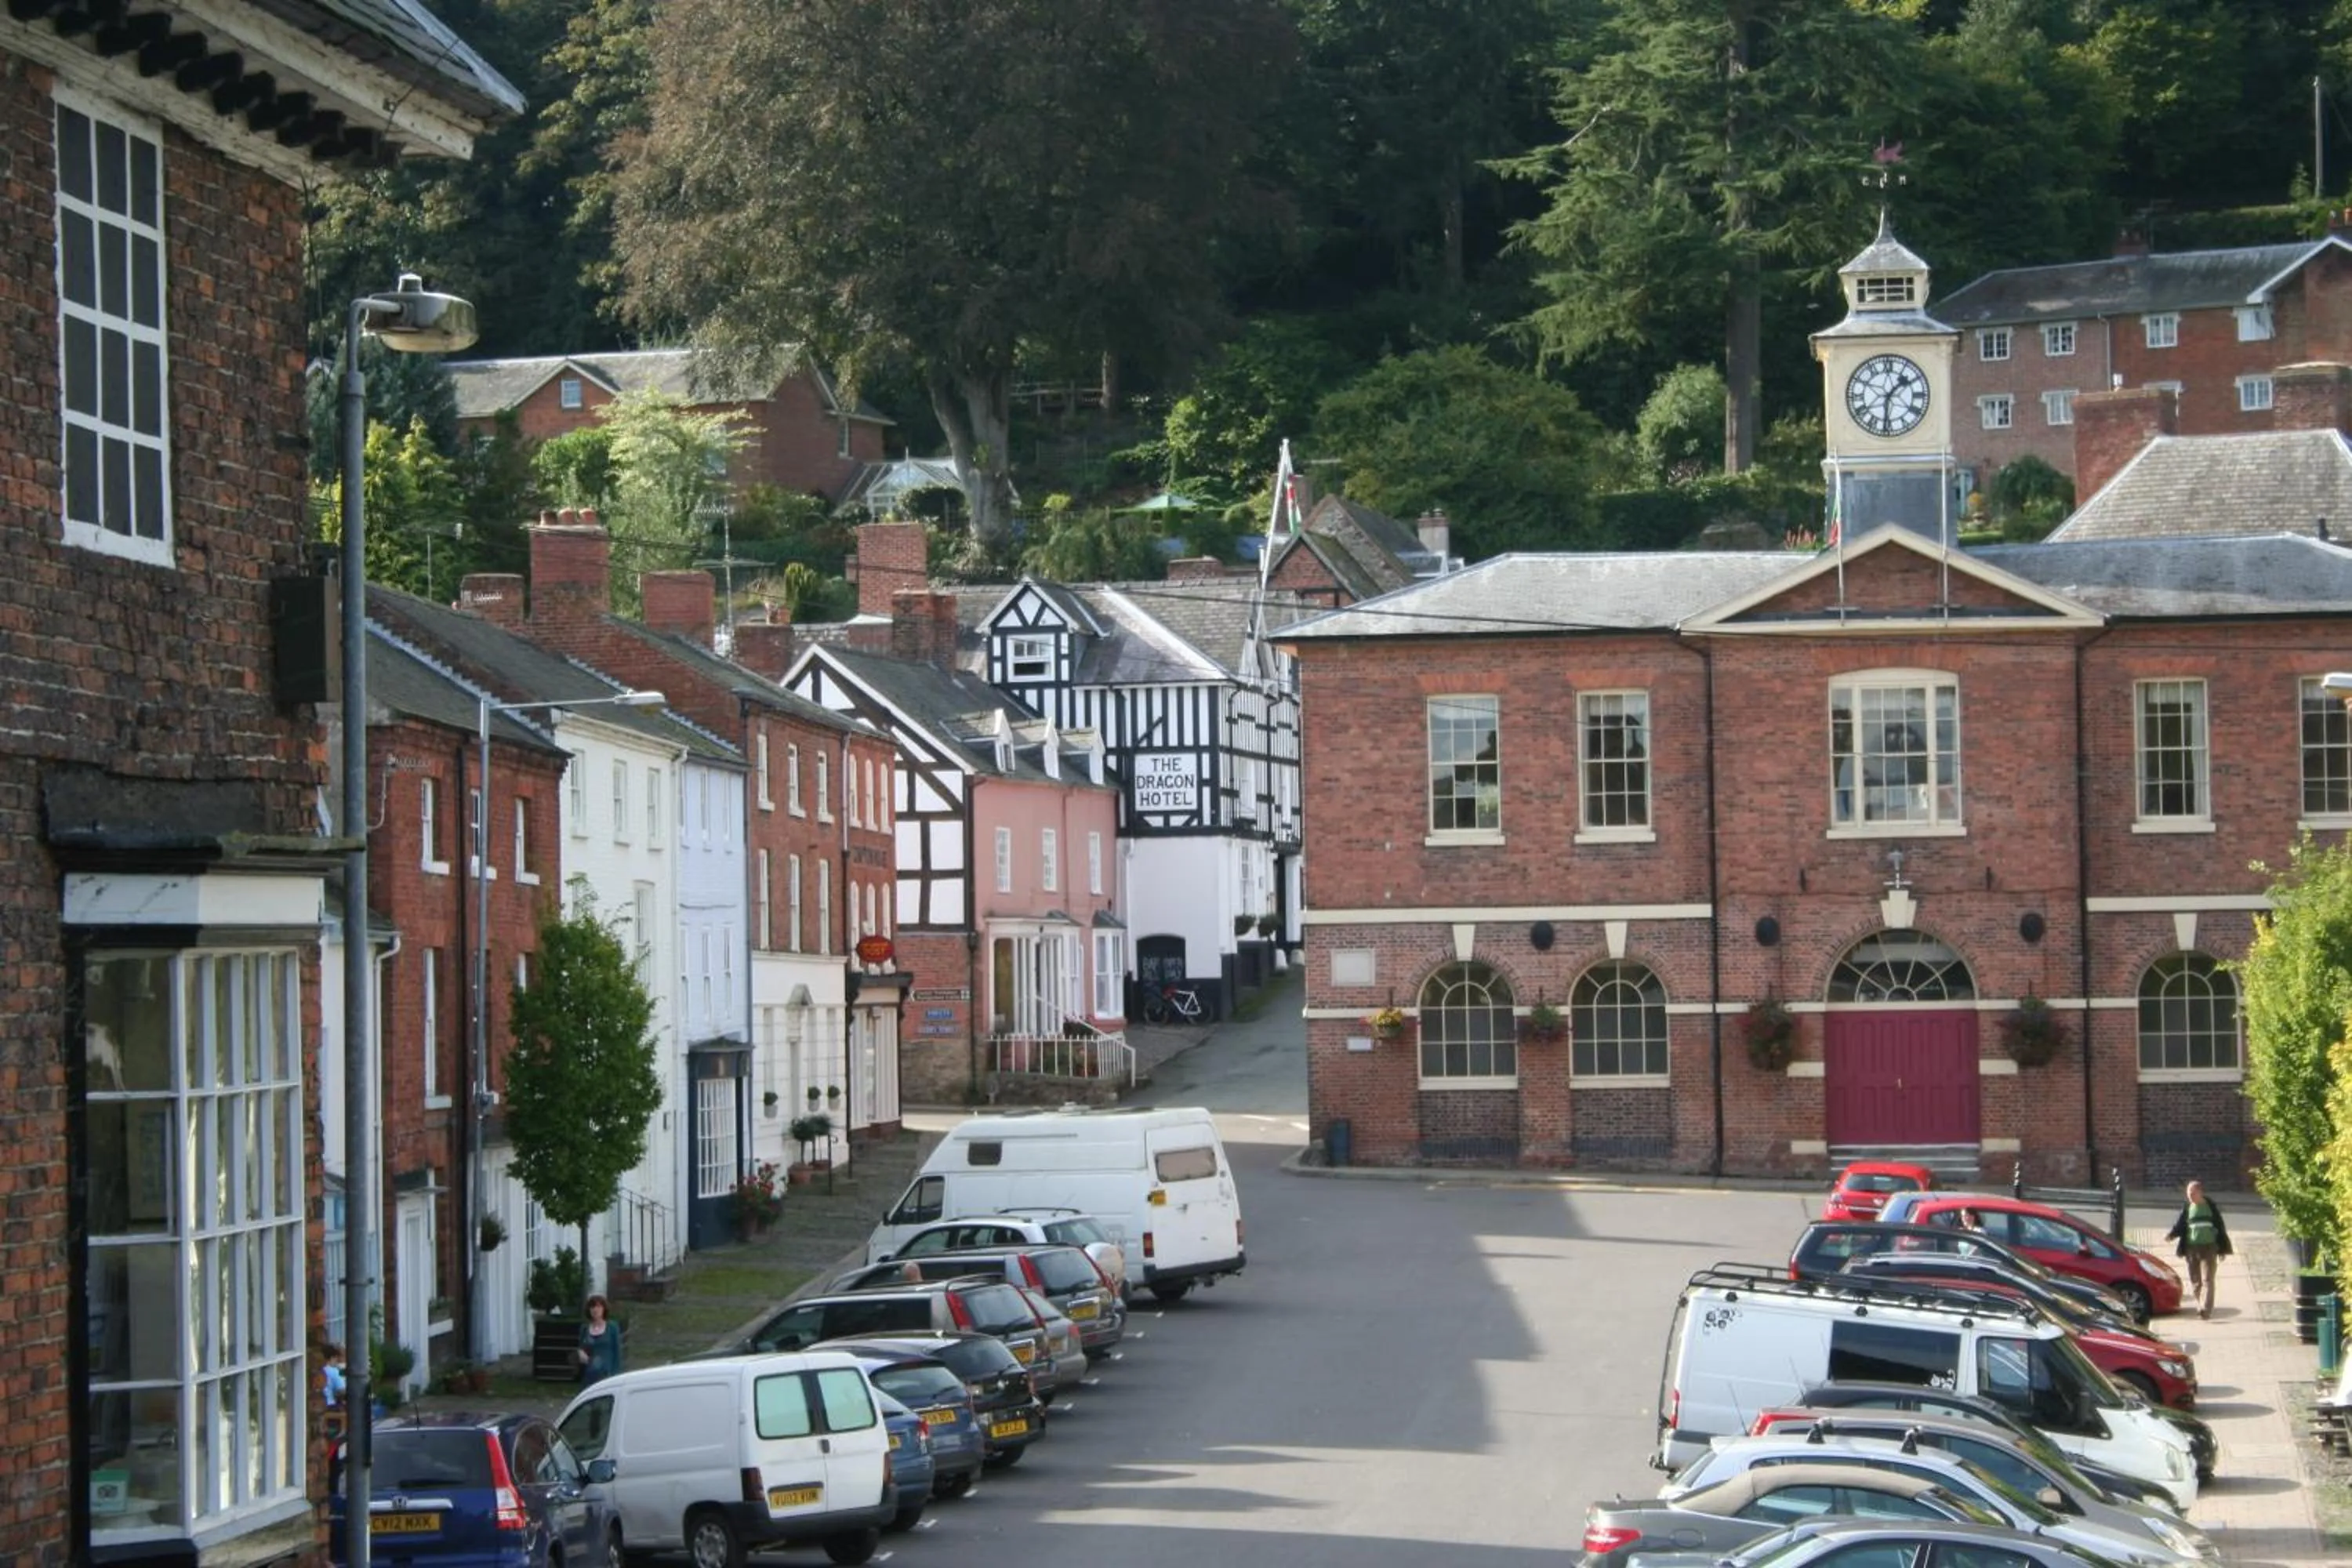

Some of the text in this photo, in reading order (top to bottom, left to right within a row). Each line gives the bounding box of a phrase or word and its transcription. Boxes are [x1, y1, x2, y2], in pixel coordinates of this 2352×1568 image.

[1151, 757, 1182, 772] THE
[1137, 774, 1195, 789] DRAGON
[1139, 791, 1192, 807] HOTEL
